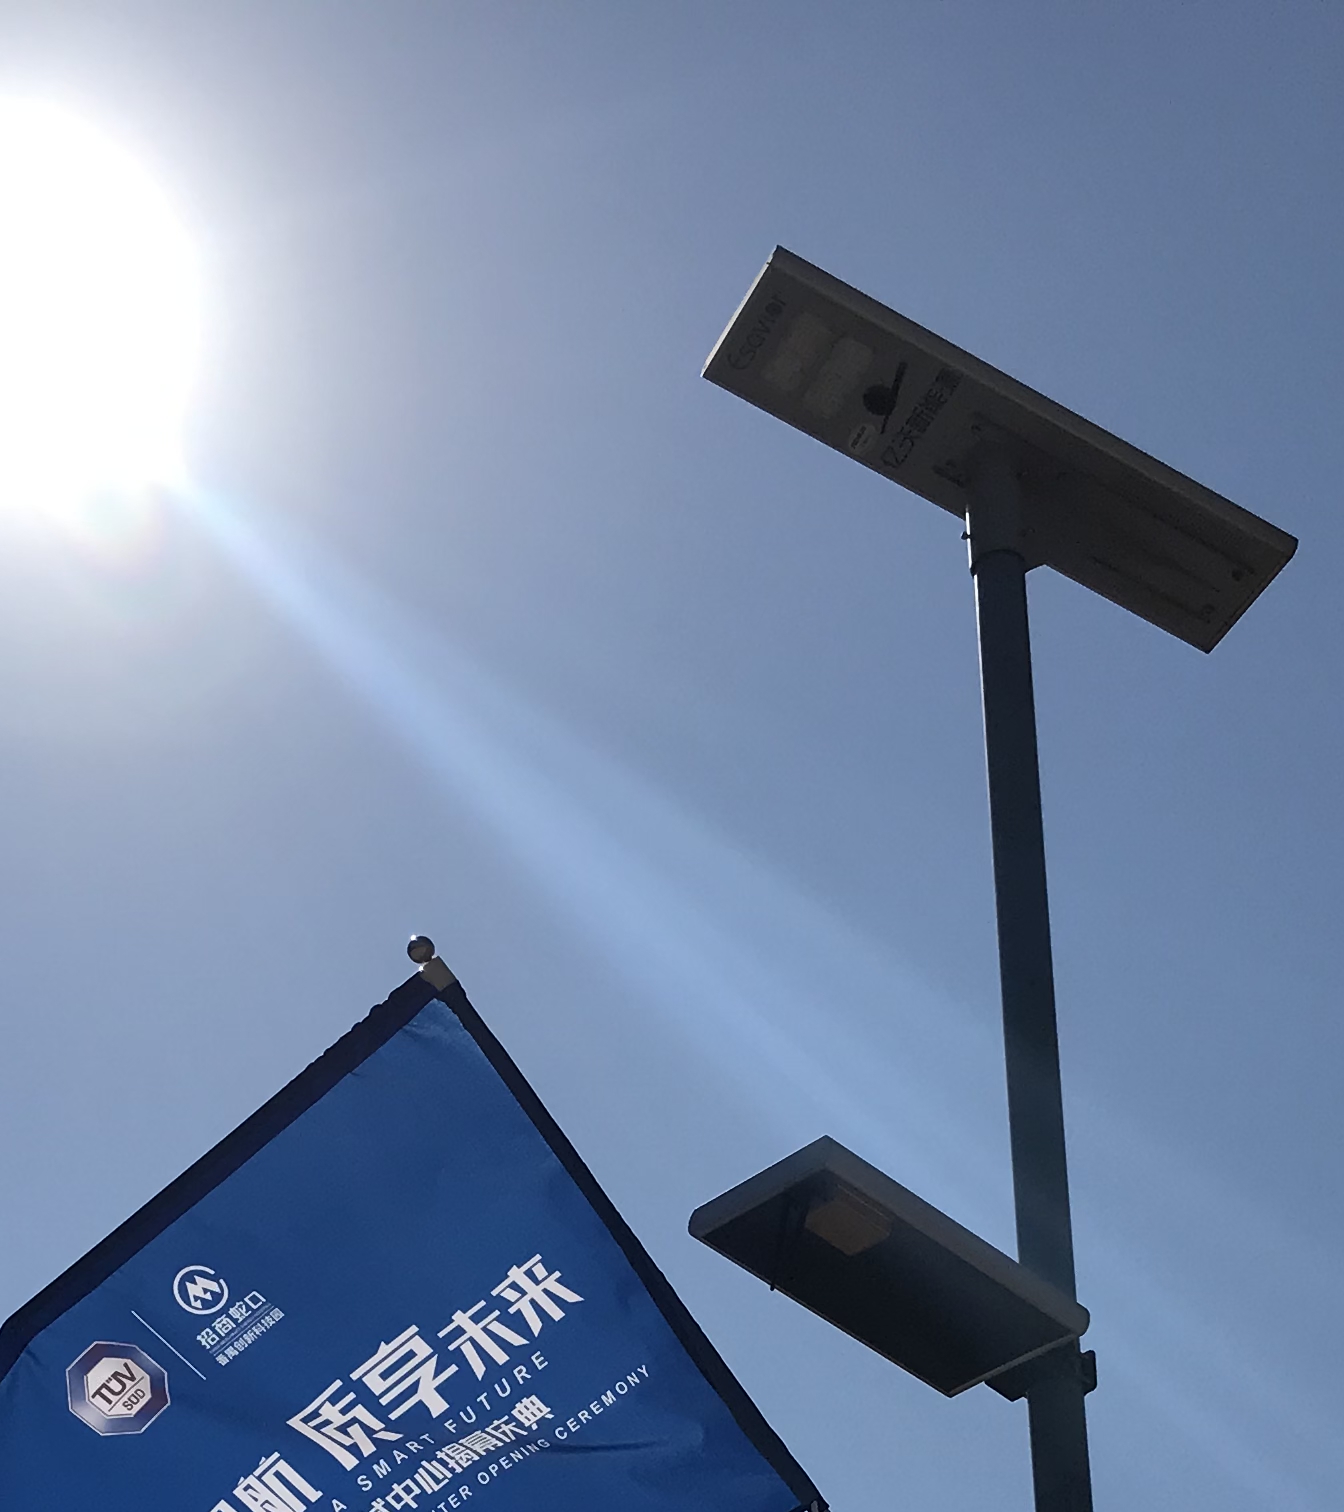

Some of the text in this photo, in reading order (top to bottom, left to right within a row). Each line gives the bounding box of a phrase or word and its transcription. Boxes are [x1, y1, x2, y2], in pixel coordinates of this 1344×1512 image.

[196, 1290, 266, 1349] 招商蛇口
[286, 1253, 585, 1471] 质享未来
[91, 1362, 137, 1406] TÜV
[357, 1433, 436, 1492] SMART
[444, 1350, 549, 1434] FUTURE
[477, 1438, 551, 1485] OPENING
[554, 1364, 651, 1440] CEREMONY
